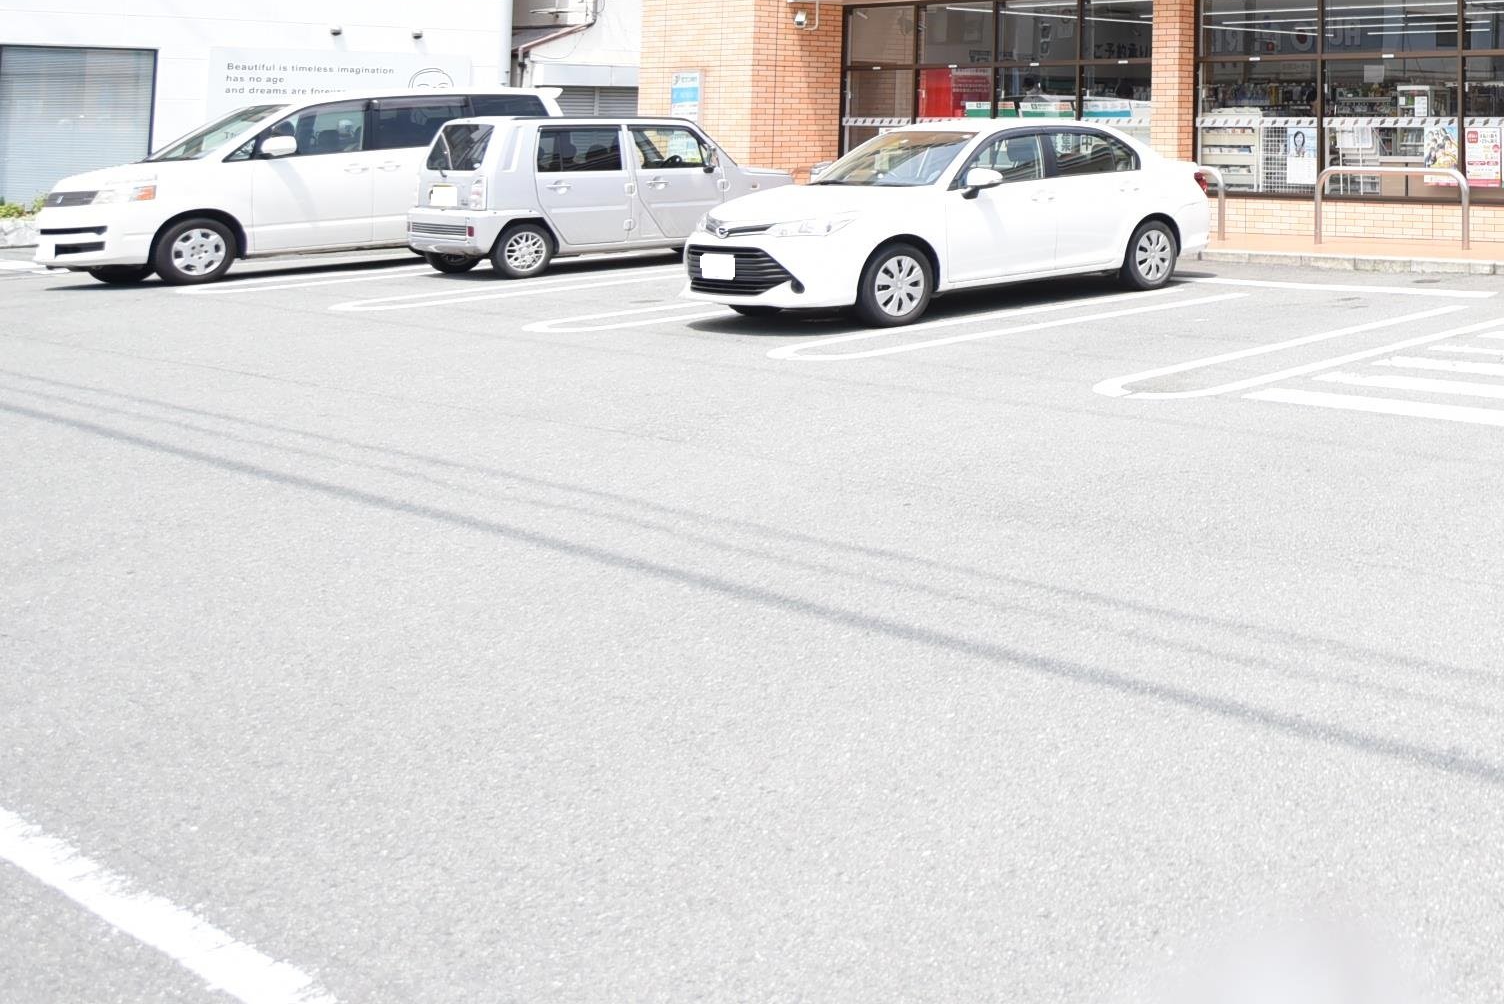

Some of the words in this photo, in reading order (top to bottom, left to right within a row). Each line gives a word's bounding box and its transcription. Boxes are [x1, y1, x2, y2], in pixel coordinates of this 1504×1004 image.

[227, 62, 276, 72] Beautiful
[278, 64, 288, 72] is
[291, 64, 334, 73] timeless
[337, 65, 395, 75] imagination
[226, 75, 244, 83] has
[265, 76, 285, 85] age
[225, 86, 244, 94] and
[248, 86, 287, 95] dreams
